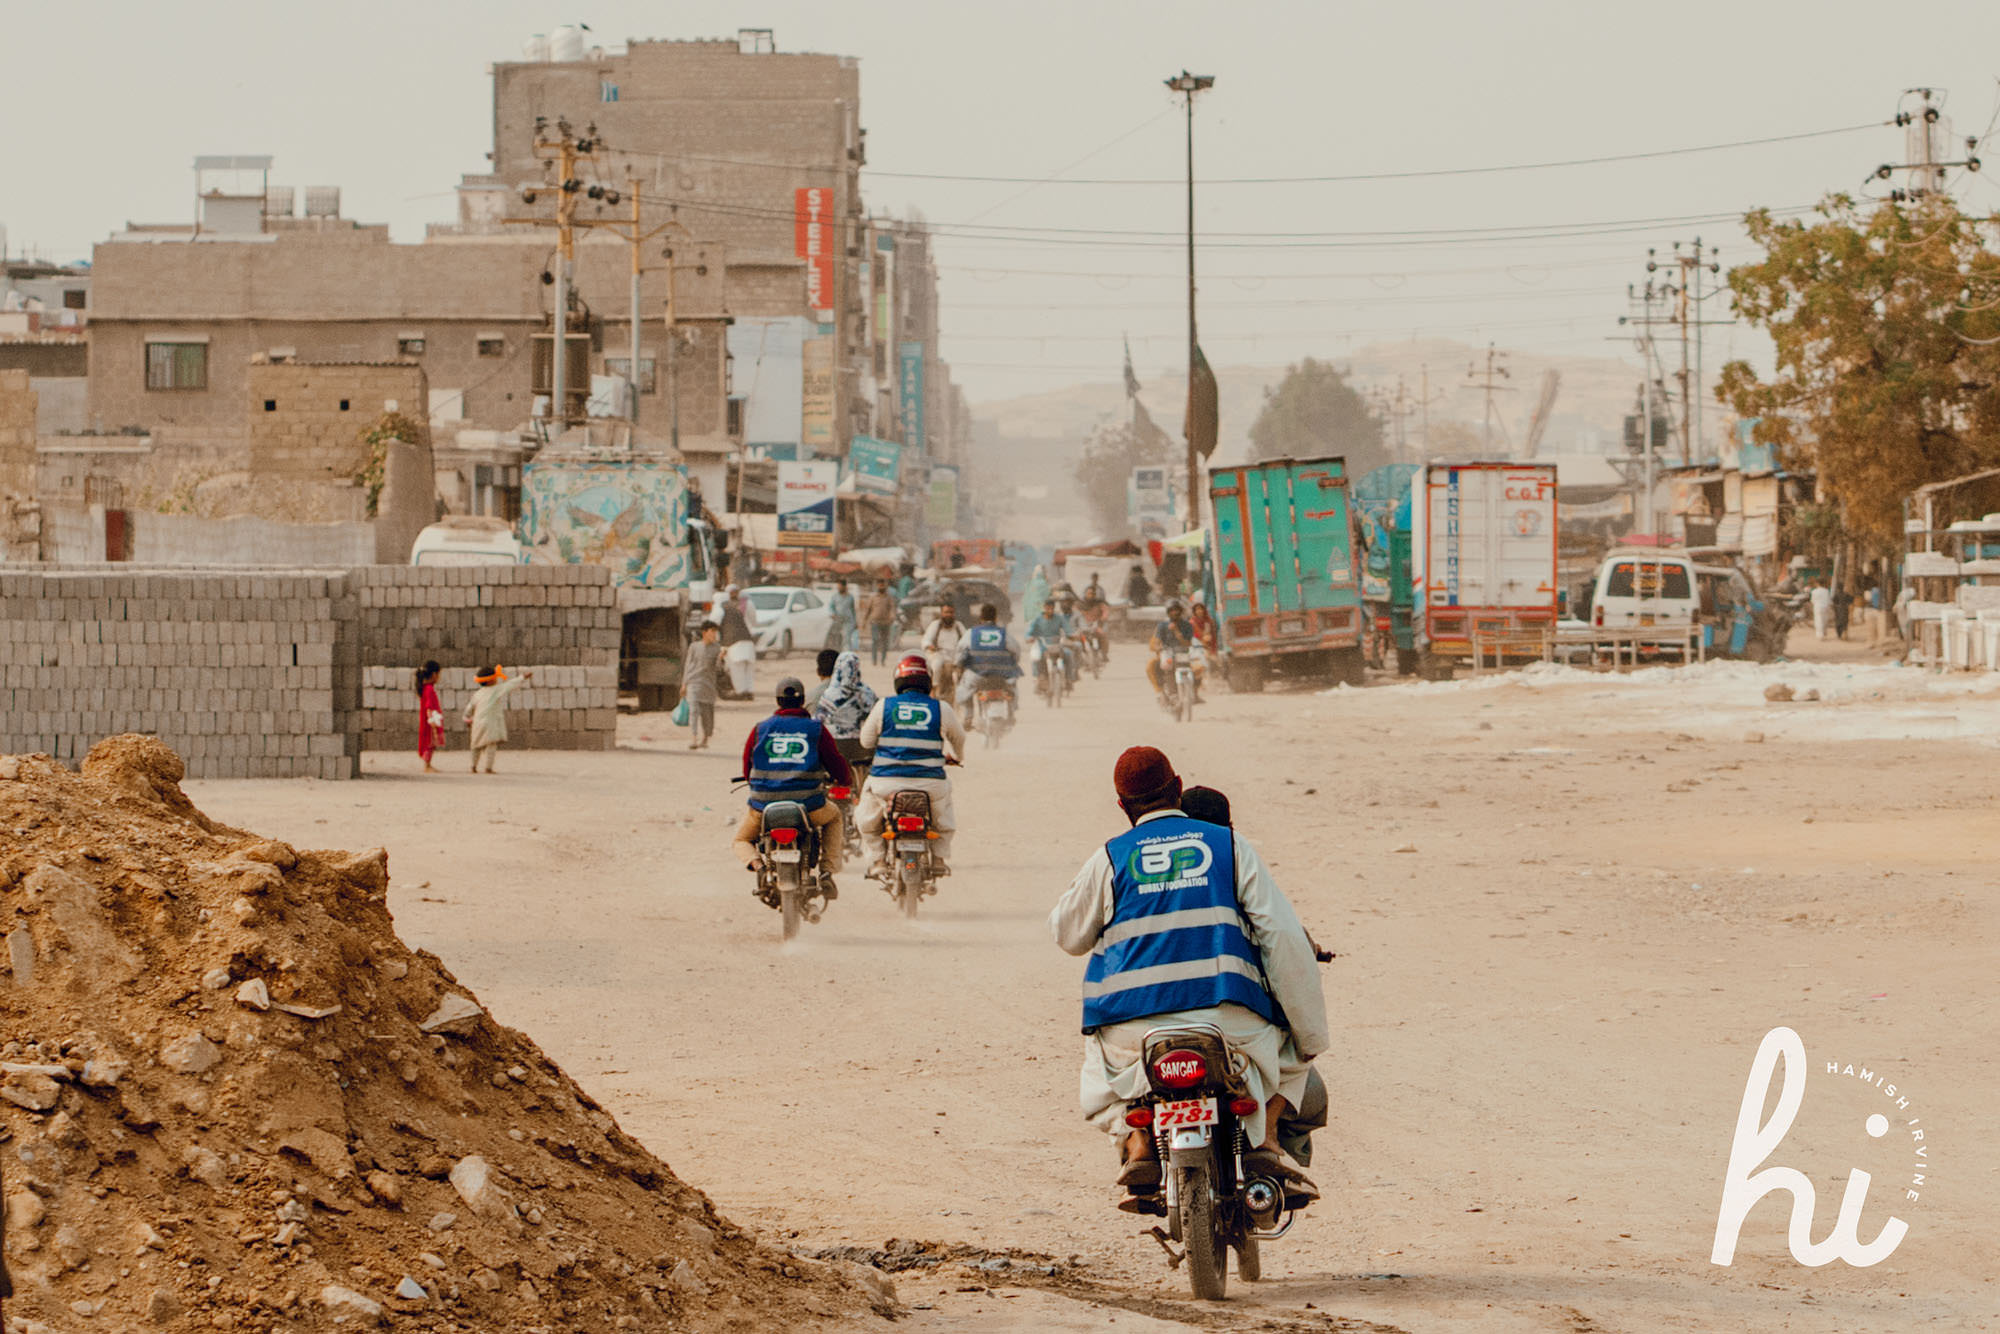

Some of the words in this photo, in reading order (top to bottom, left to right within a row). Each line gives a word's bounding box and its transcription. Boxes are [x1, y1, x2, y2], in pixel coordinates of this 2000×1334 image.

[807, 189, 822, 306] STEELEX
[1160, 1061, 1198, 1079] SANGAT
[1159, 1108, 1213, 1126] 7181
